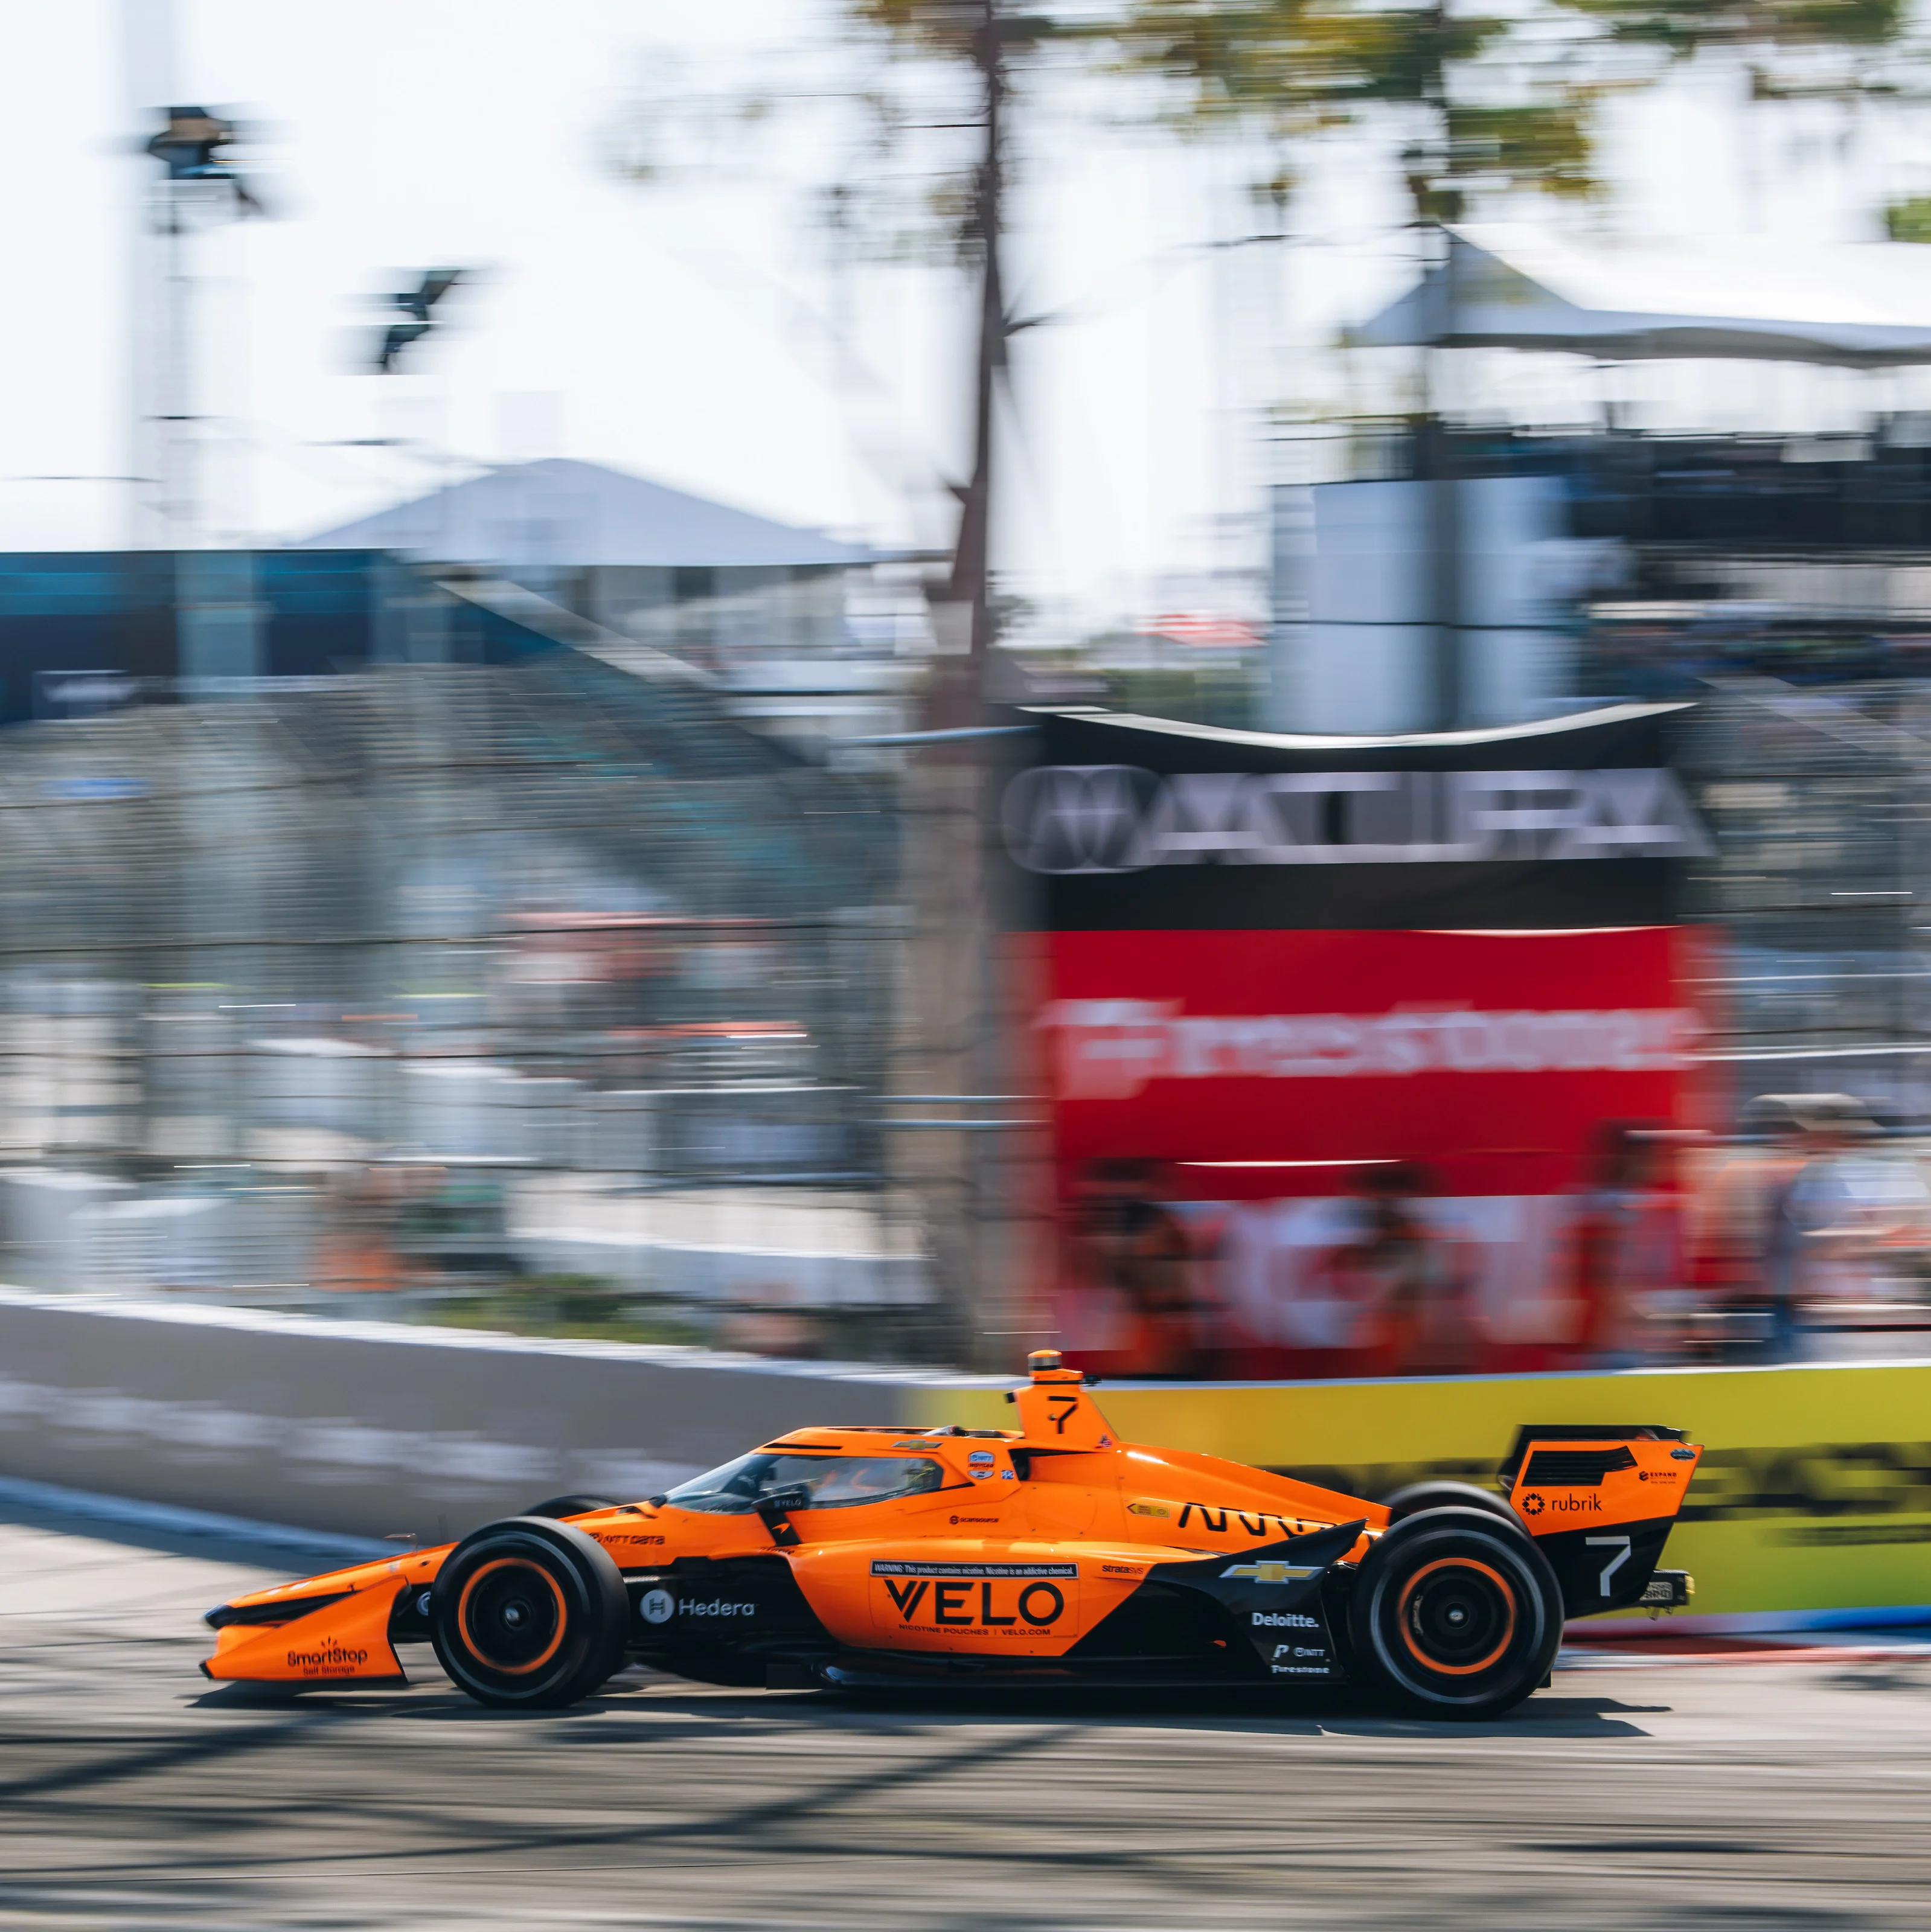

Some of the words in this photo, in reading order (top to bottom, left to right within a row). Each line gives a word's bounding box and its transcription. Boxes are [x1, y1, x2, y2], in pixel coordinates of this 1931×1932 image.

[1123, 768, 1717, 865] ACURA
[1039, 999, 1700, 1098] Firestone
[1047, 1396, 1078, 1434] 7
[1552, 1493, 1602, 1511] rubrik
[875, 1564, 905, 1573] WARNING:
[905, 1564, 917, 1573] This
[917, 1566, 938, 1575] product
[938, 1566, 962, 1575] contains
[962, 1567, 984, 1575] nicotine.
[985, 1567, 1009, 1575] Nicotine
[1010, 1567, 1015, 1575] is
[1023, 1567, 1048, 1575] addictive
[1048, 1567, 1074, 1575] chemical.
[1102, 1565, 1144, 1575] stratasys
[1585, 1535, 1631, 1597] 7
[679, 1598, 754, 1616] Hedera
[884, 1579, 1065, 1627] VELO
[898, 1624, 940, 1634] NICOTINE
[1252, 1612, 1319, 1628] Deloitte.
[287, 1647, 368, 1667] SmartStop
[1270, 1665, 1330, 1674] Firestone
